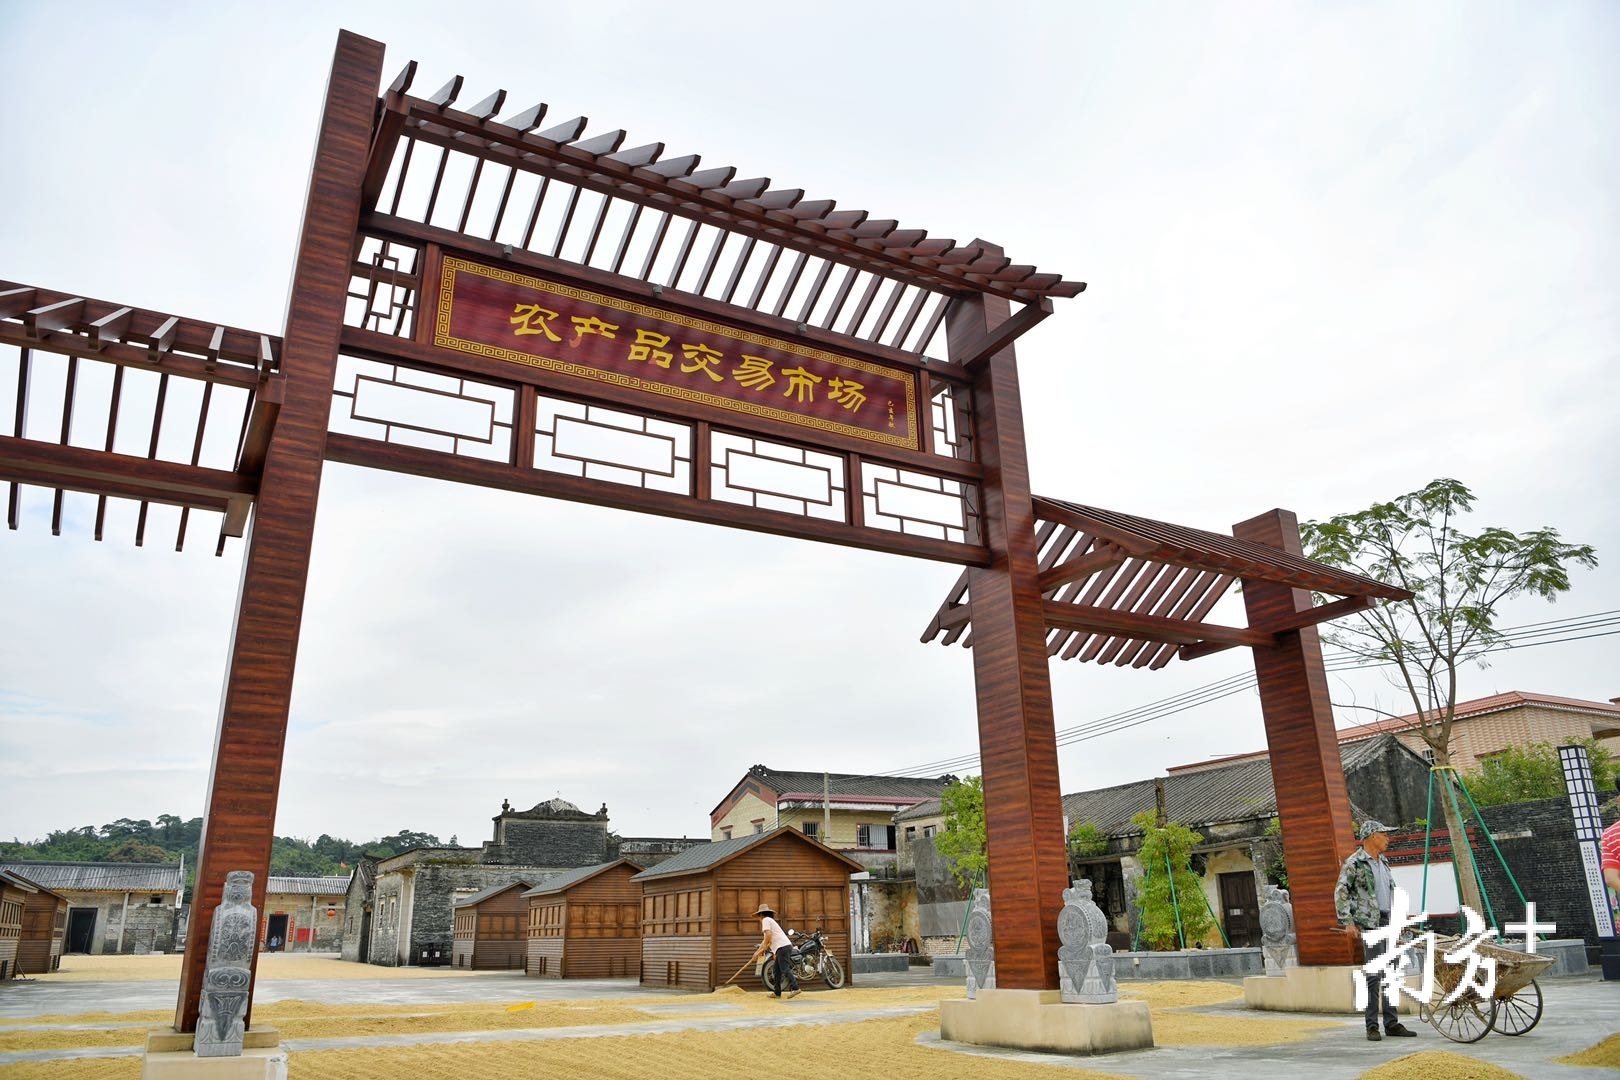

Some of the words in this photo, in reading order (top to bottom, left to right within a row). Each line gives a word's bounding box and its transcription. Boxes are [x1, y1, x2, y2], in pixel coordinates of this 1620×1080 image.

[509, 302, 867, 415] 农产品交易市场
